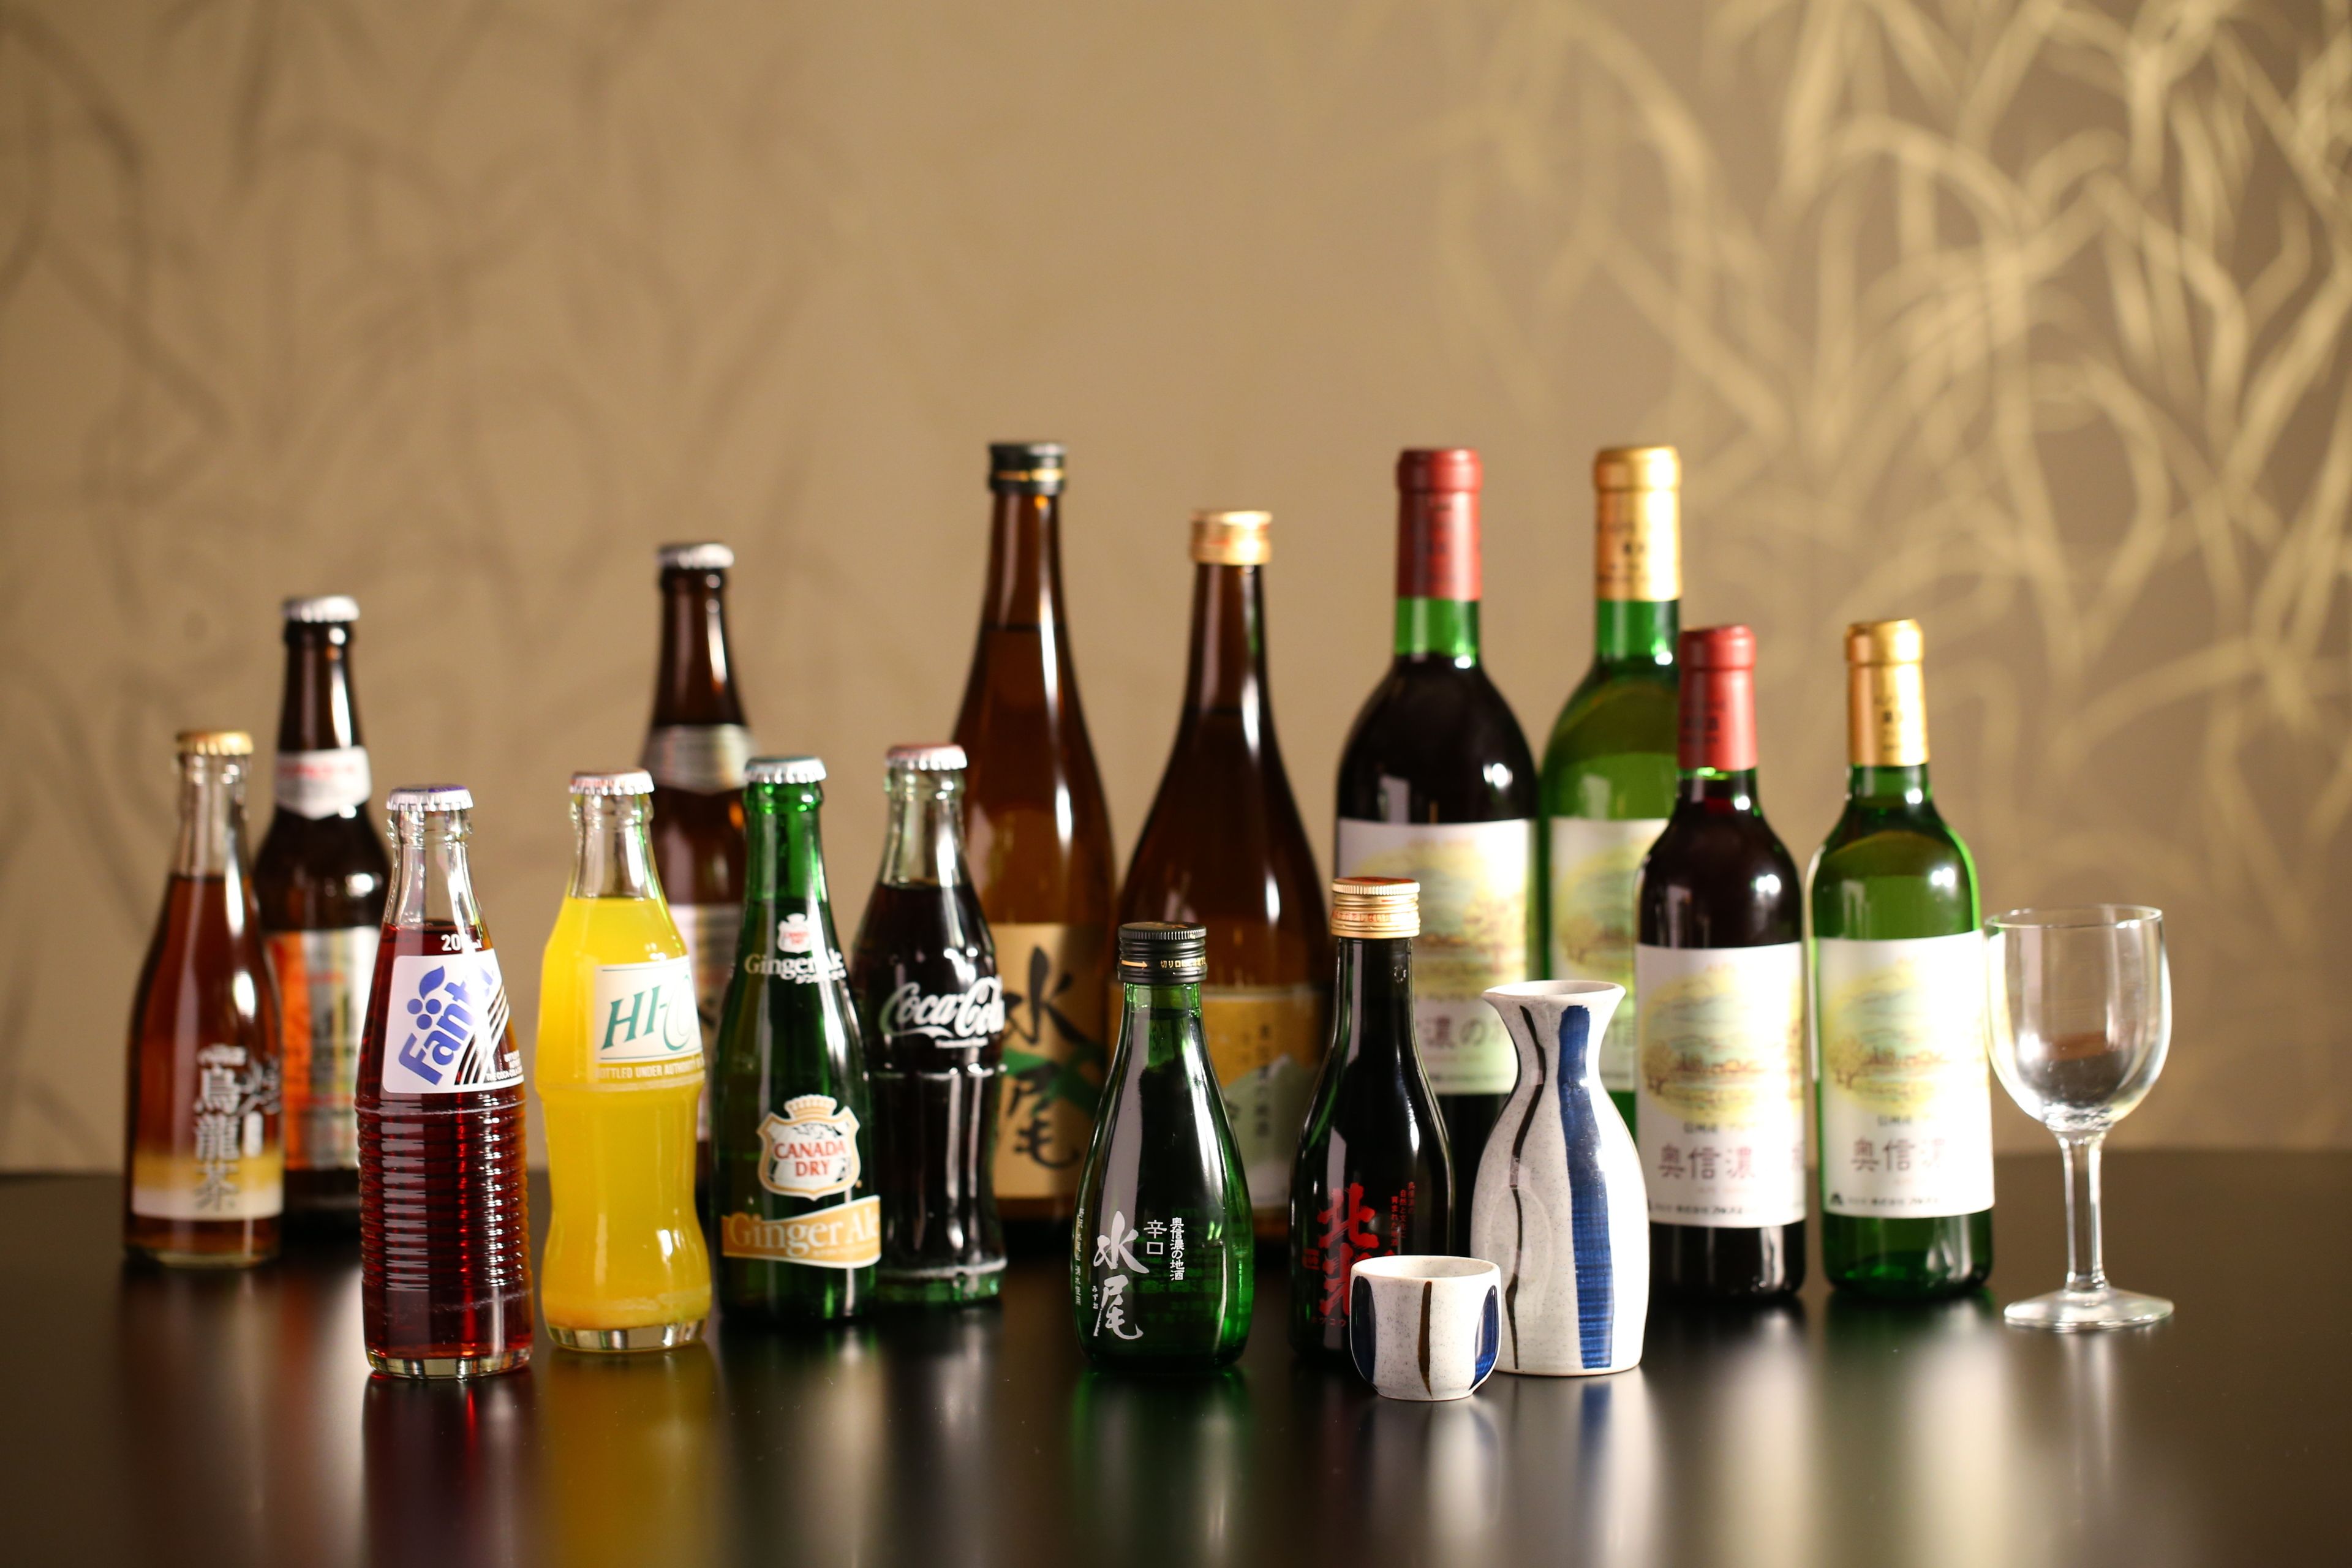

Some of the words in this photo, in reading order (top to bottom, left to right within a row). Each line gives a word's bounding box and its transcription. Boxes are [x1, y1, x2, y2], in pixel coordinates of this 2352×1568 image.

[635, 1065, 663, 1077] UNDER
[774, 1140, 846, 1159] CANADA
[795, 1161, 830, 1177] DRY
[729, 1213, 843, 1257] Ginger
[1144, 1219, 1167, 1255] 辛口
[1170, 1217, 1185, 1281] 奥信濃の地酒
[1093, 1211, 1150, 1340] 水尾
